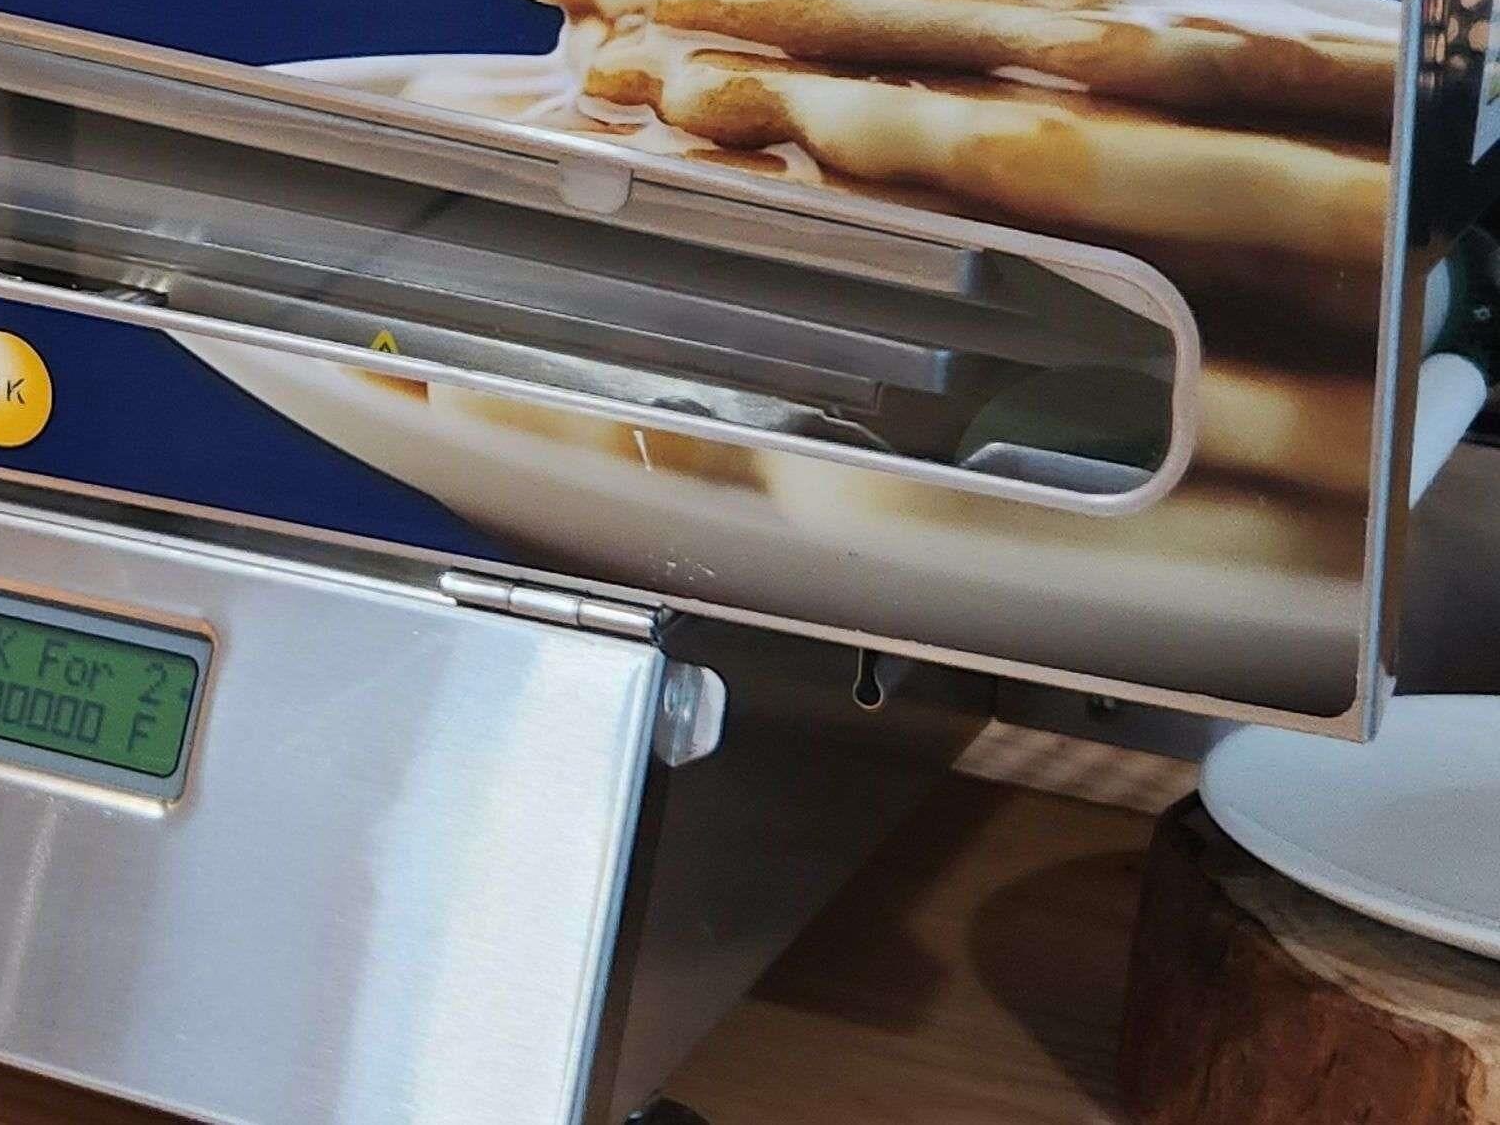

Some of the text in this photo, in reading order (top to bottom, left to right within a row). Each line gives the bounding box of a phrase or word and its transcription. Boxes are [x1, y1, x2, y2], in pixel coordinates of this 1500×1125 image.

[38, 638, 116, 690] For
[138, 663, 169, 707] 2
[126, 711, 157, 754] F
